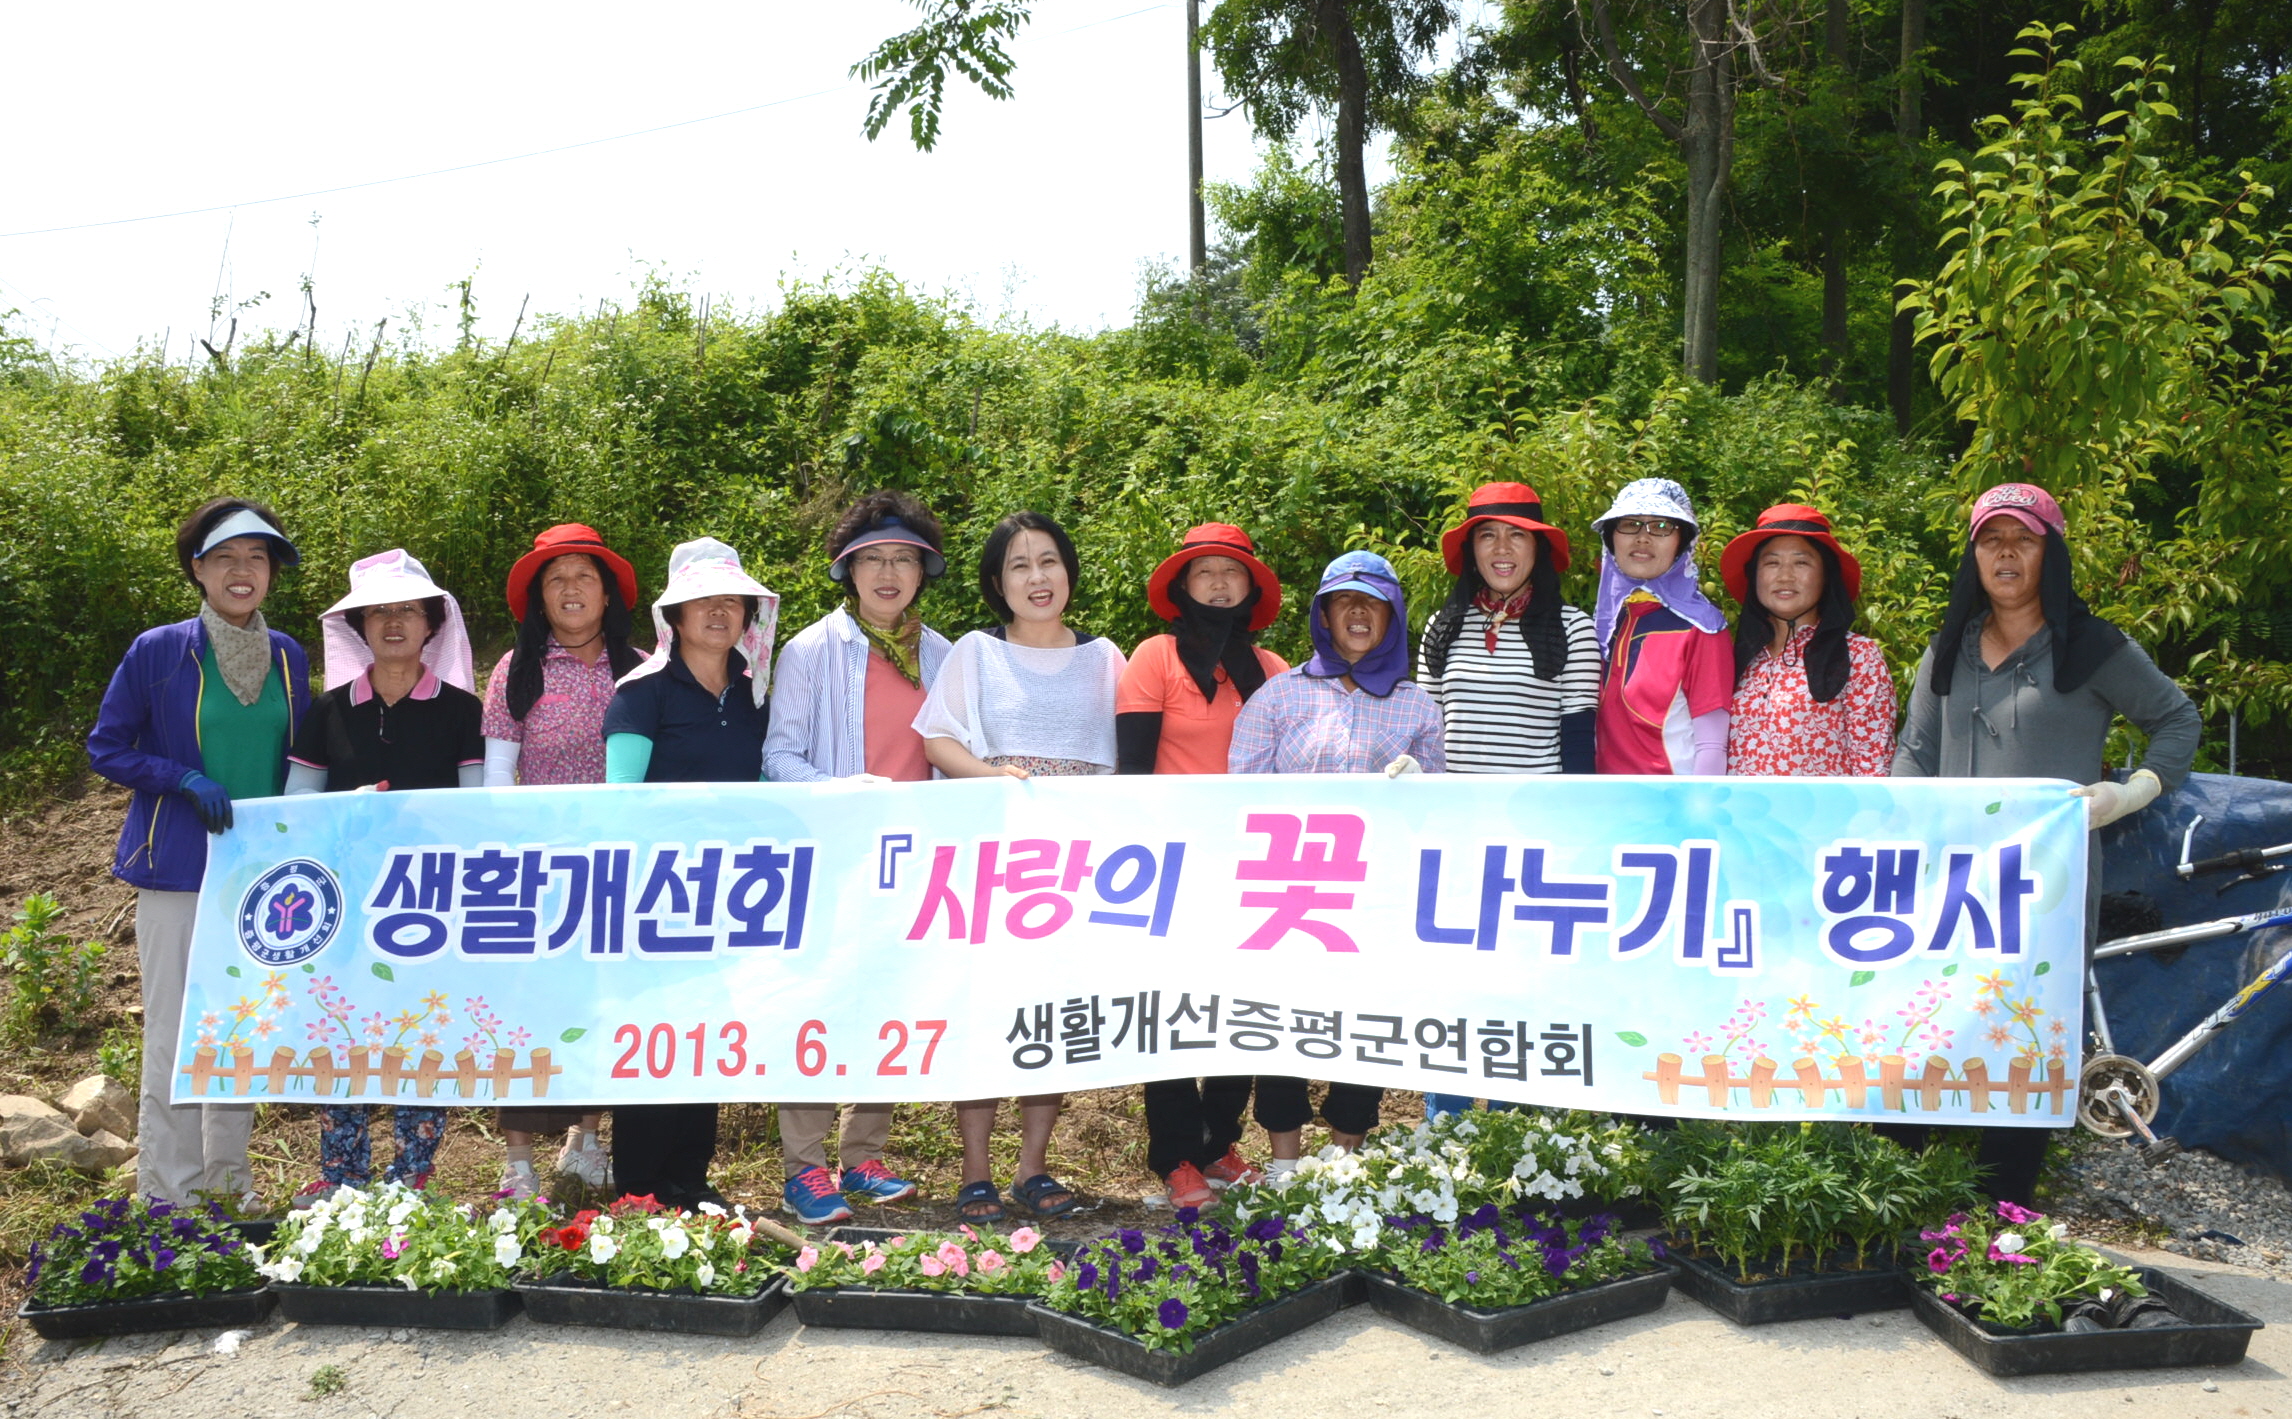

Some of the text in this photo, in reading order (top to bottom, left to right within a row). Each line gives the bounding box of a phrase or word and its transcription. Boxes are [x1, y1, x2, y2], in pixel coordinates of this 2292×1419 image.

[370, 813, 2034, 968] 생활개선회 『사랑의 꽃 나누기』 행사
[612, 1019, 948, 1079] 2013. 6. 27
[1005, 990, 1594, 1087] 생활개선증평군연합회
